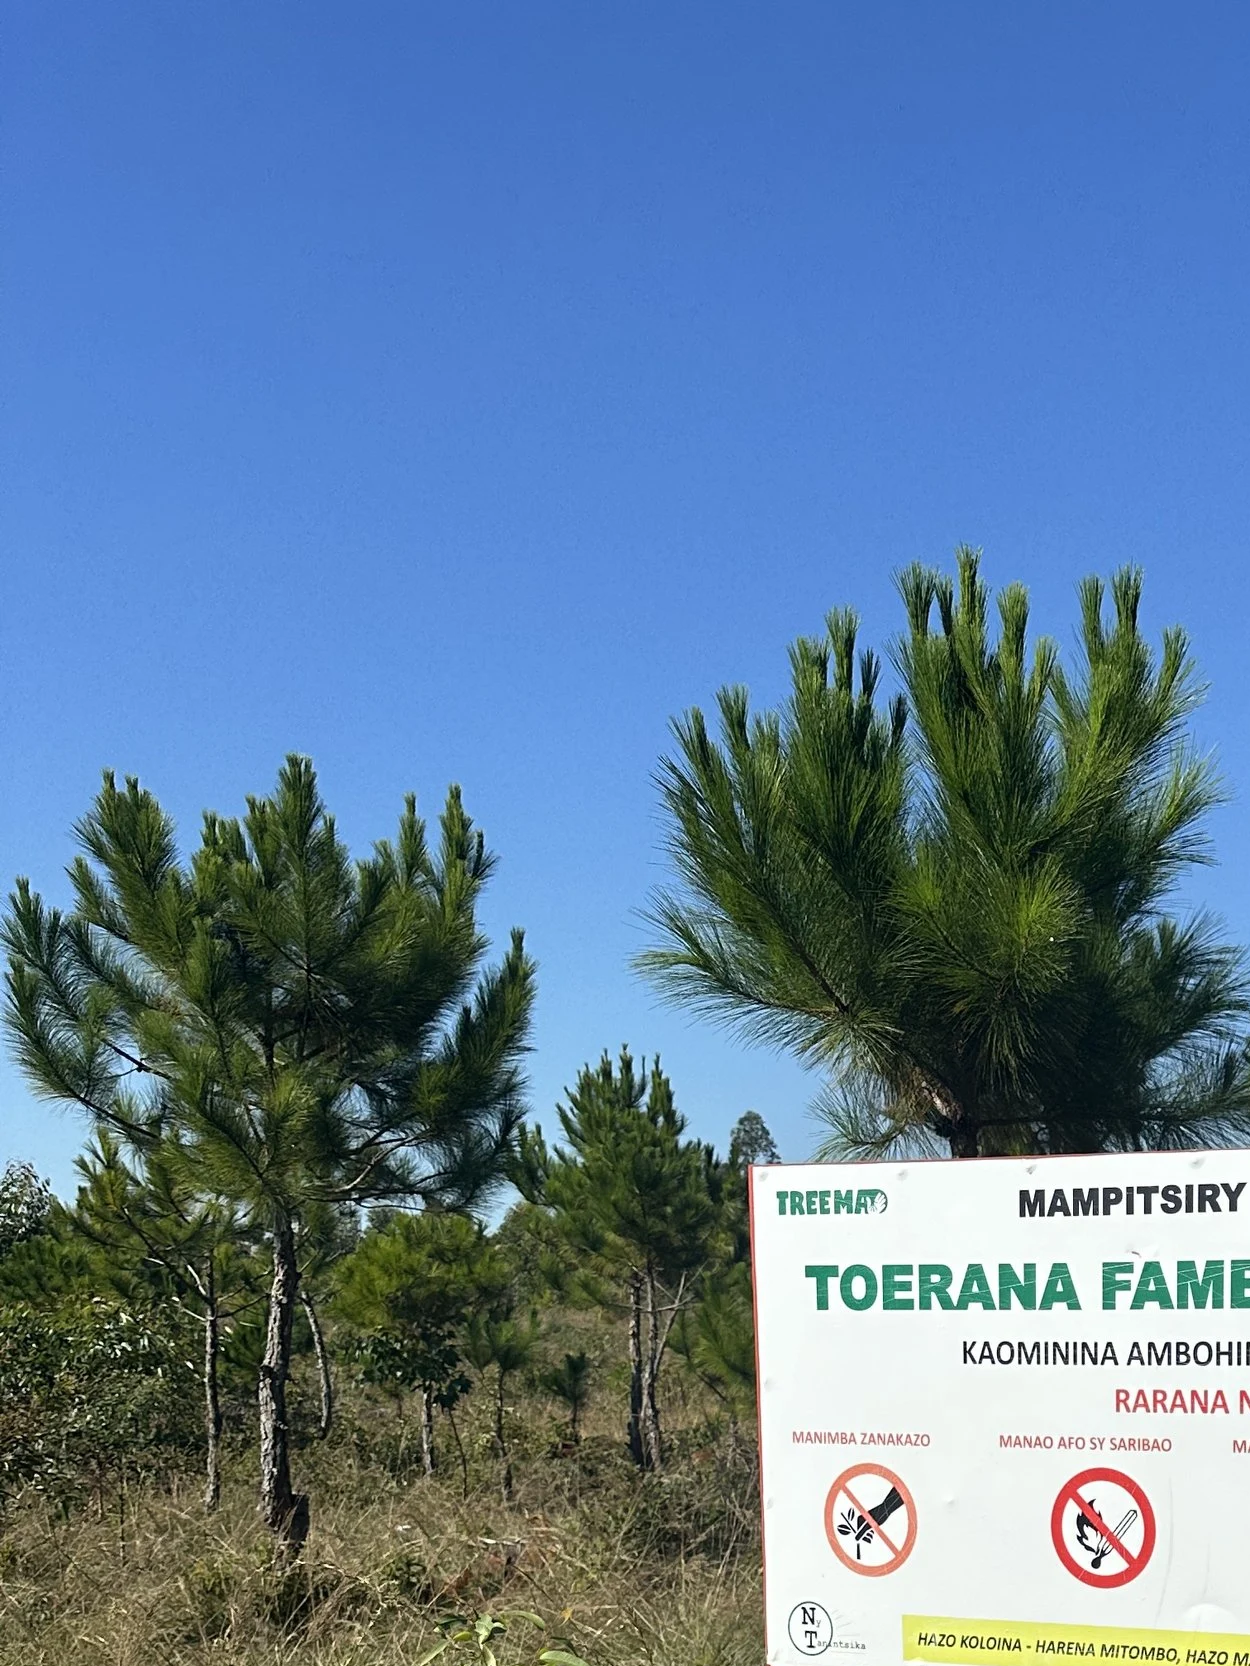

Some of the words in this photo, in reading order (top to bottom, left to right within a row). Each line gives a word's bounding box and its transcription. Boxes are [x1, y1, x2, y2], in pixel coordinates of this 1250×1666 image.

[1020, 1183, 1247, 1217] MAMPITSIRY
[805, 1263, 1081, 1311] TOERANA
[963, 1341, 1118, 1365] KAOMININA
[1116, 1390, 1229, 1413] RARANA
[793, 1432, 856, 1444] MANIMBA
[861, 1433, 930, 1446] ZANAKAZO
[1000, 1435, 1053, 1449] MANAO
[1058, 1437, 1085, 1449] AFO
[1090, 1437, 1105, 1450] SY
[1110, 1438, 1171, 1451] SARIBAO
[801, 1606, 821, 1628] Ny
[918, 1632, 956, 1647] HAZO
[961, 1635, 1021, 1652] KOLOINA
[1036, 1640, 1095, 1656] HARENA
[1100, 1644, 1180, 1664] MITOMBO,
[1186, 1649, 1228, 1665] HAZO
